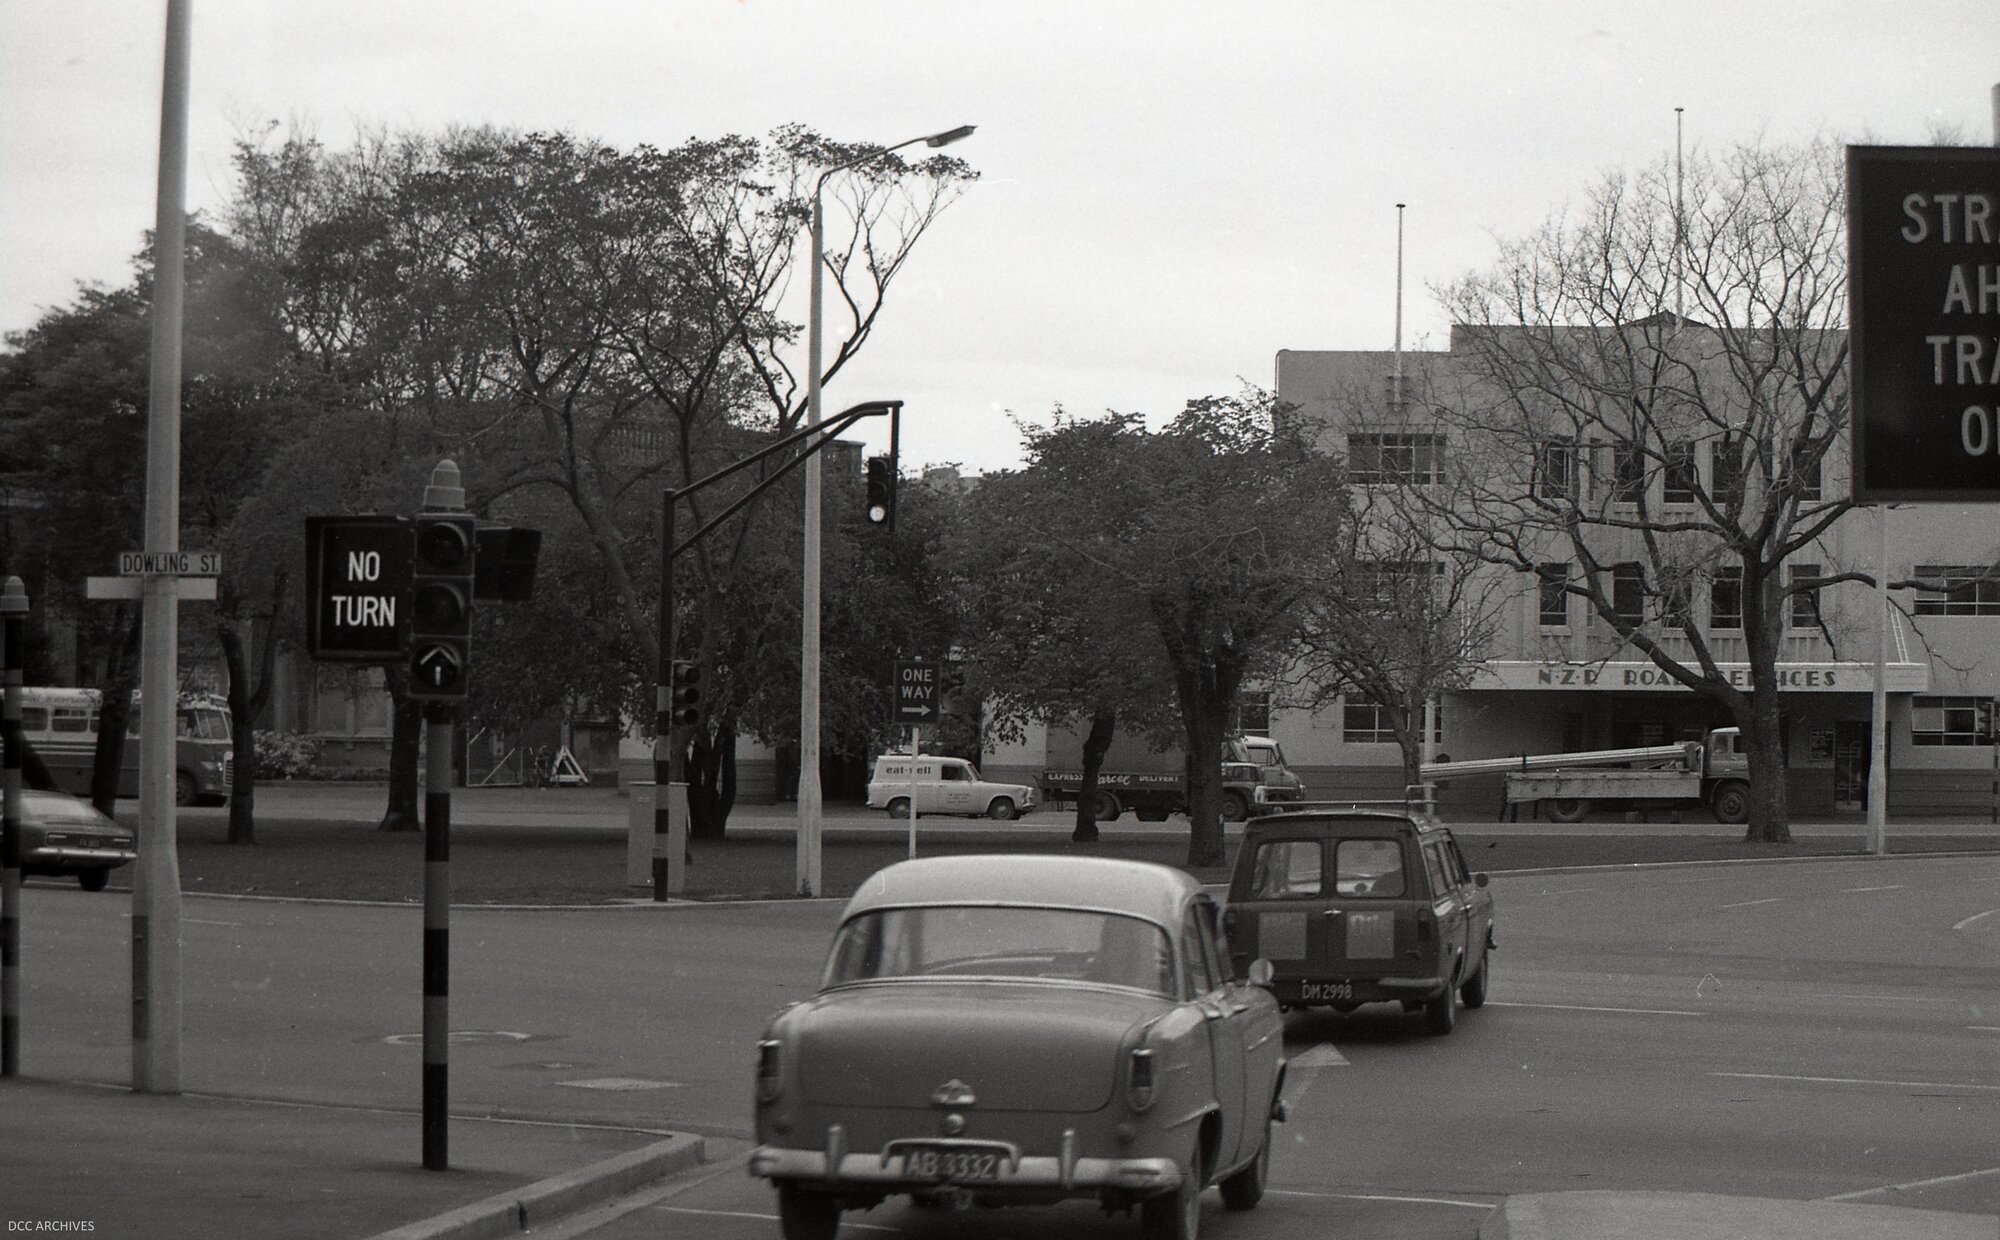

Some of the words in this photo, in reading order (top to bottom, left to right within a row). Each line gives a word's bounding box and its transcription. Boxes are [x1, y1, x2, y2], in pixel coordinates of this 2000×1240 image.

[1900, 192, 2000, 244] STR
[122, 553, 189, 573] DOWLING
[200, 553, 219, 573] ST.
[347, 550, 381, 582] NO
[331, 595, 396, 627] TURN
[902, 668, 933, 682] ONE
[901, 685, 934, 699] WAY
